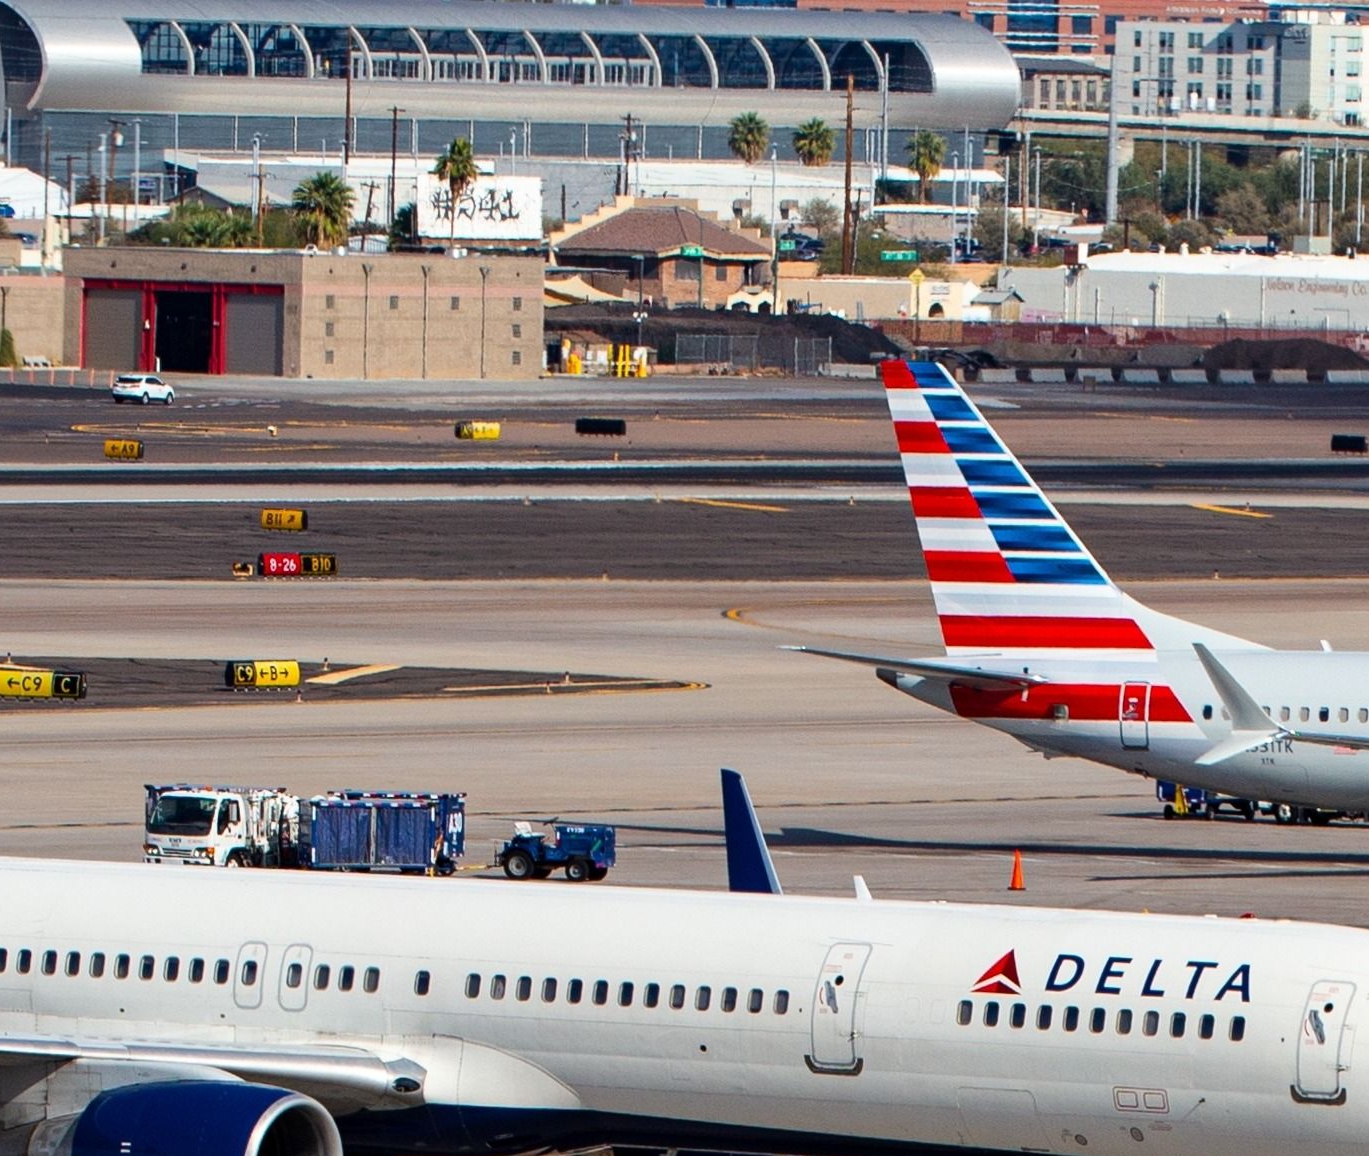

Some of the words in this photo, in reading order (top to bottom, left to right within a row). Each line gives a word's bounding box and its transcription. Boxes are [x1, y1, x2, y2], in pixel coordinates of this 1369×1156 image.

[121, 444, 136, 456] A9
[266, 512, 282, 525] B11
[269, 557, 297, 572] 8-26
[311, 557, 331, 571] B10
[237, 665, 254, 682] C9
[270, 665, 278, 681] B
[21, 676, 43, 692] C9
[60, 677, 71, 693] C
[1044, 953, 1252, 1002] DELTA
